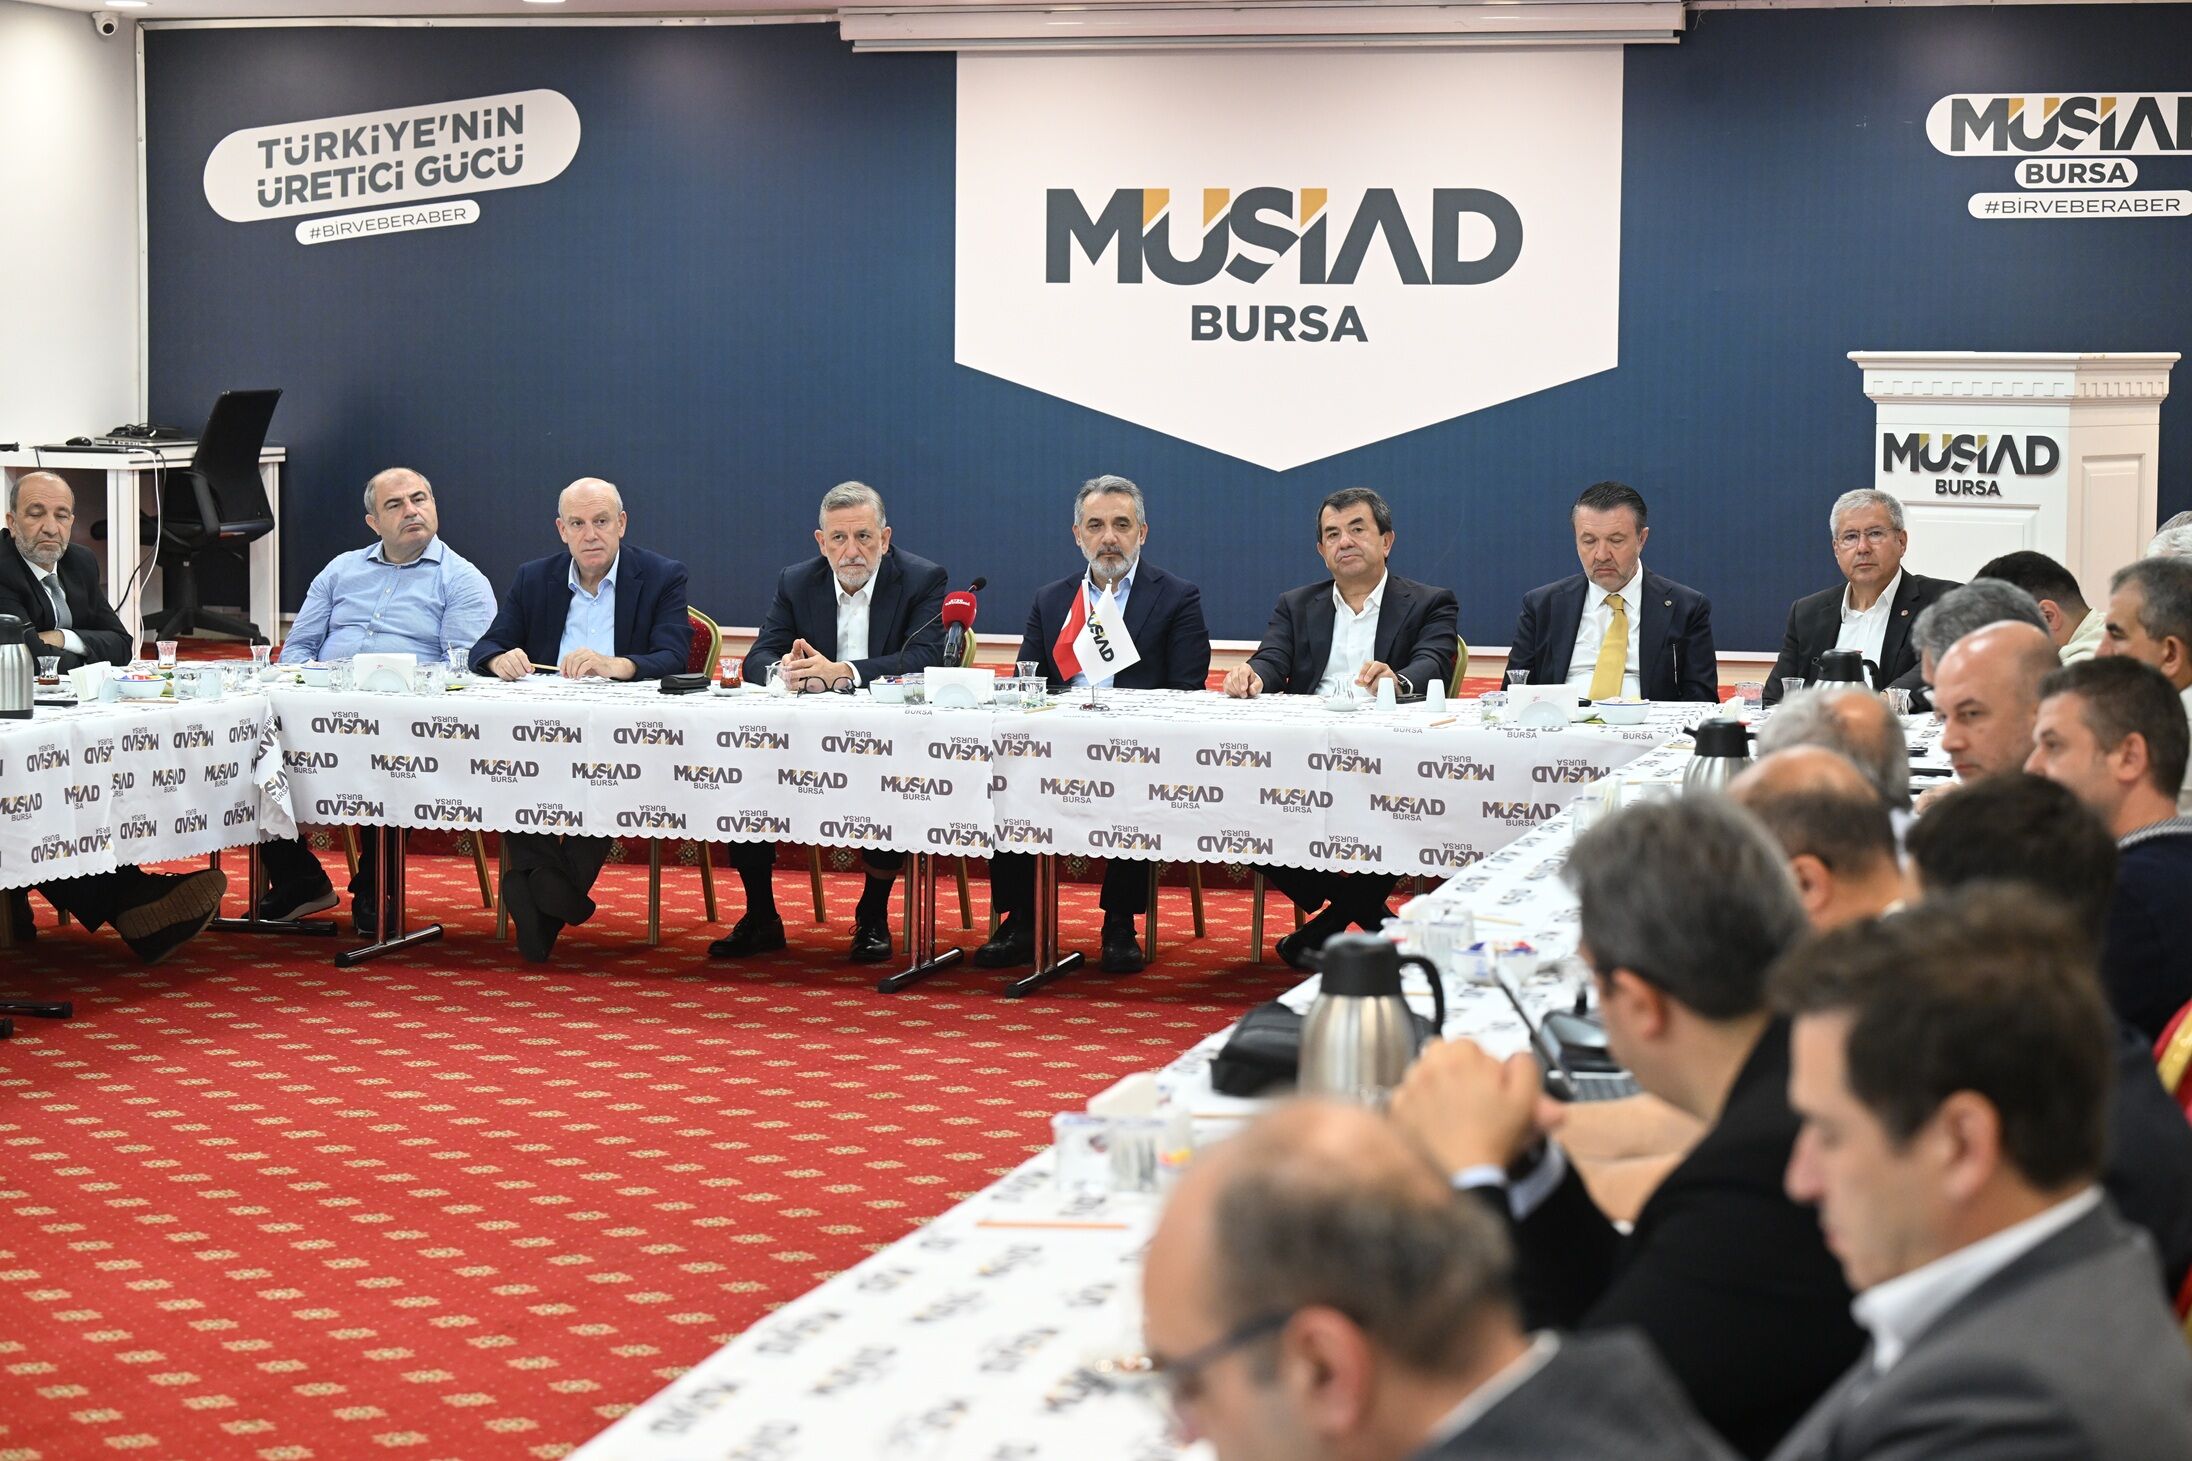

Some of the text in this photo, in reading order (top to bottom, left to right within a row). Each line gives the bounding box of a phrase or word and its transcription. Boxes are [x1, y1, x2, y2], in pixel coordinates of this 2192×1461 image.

[415, 144, 523, 187] GÜCÜ
[2026, 163, 2129, 184] BURSA
[1191, 305, 1369, 343] BURSA
[1936, 479, 2001, 496] BURSA
[1330, 747, 1359, 755] BURSA
[1442, 755, 1471, 763] BURSA
[694, 782, 720, 790] BURSA
[798, 787, 824, 795] BURSA
[1063, 796, 1092, 804] BURSA
[739, 809, 768, 817] BURSA
[1392, 813, 1422, 821] BURSA
[843, 815, 871, 823] BURSA
[1506, 819, 1536, 827] BURSA
[950, 822, 977, 830] BURSA
[1328, 835, 1359, 844] BURSA
[1443, 842, 1472, 850] BURSA
